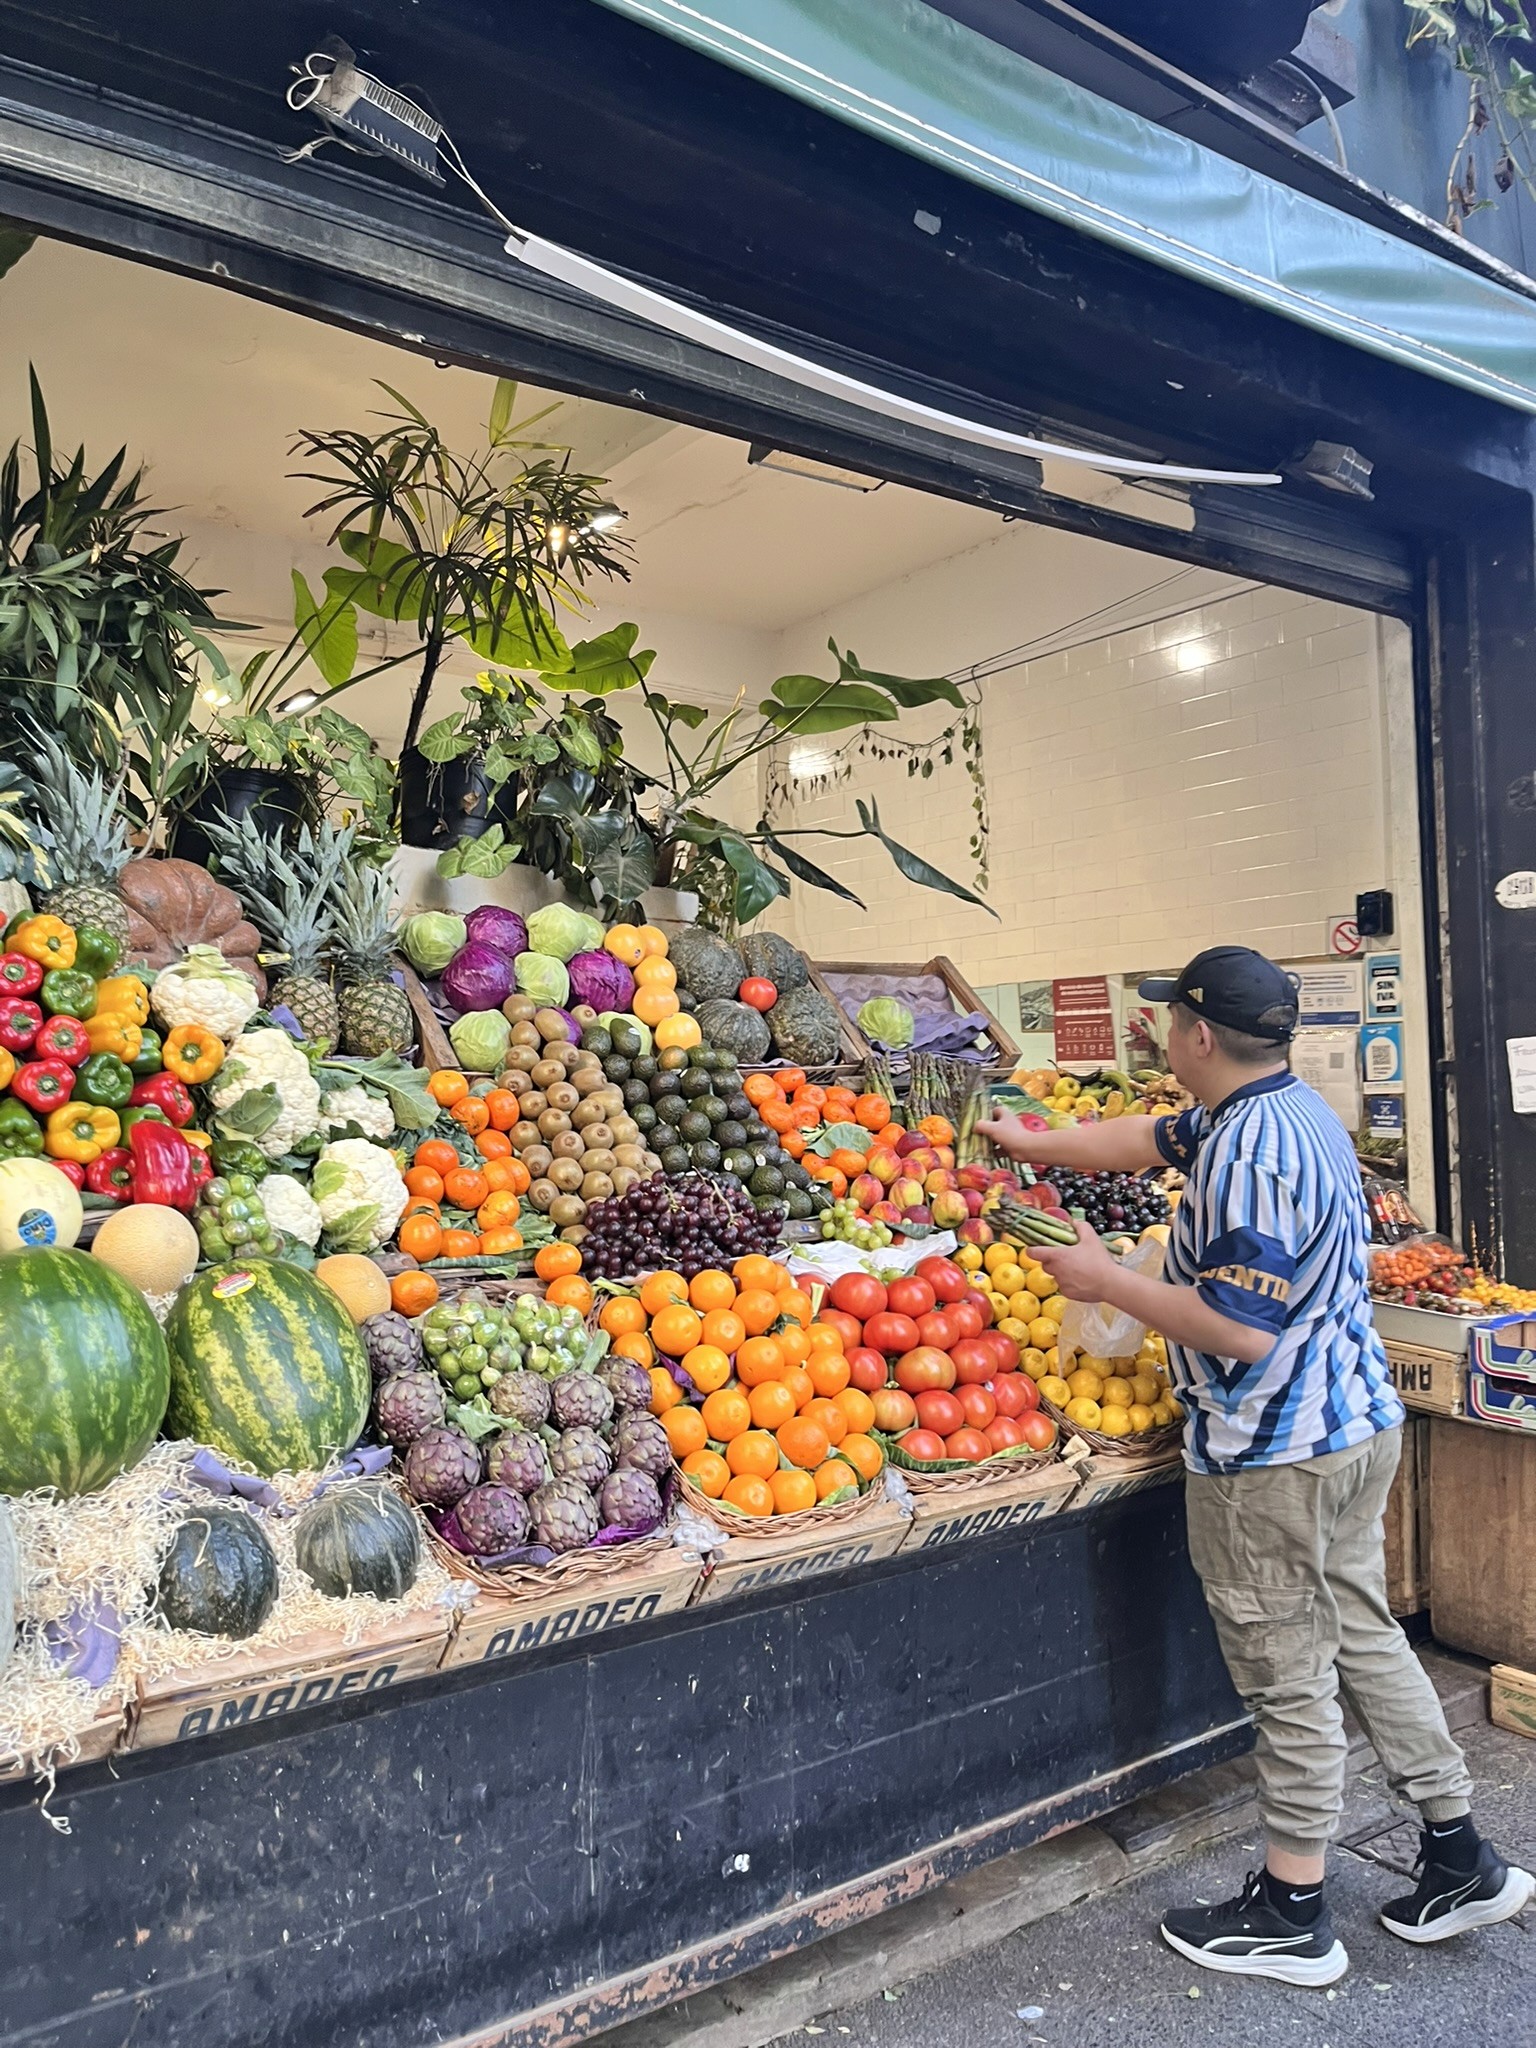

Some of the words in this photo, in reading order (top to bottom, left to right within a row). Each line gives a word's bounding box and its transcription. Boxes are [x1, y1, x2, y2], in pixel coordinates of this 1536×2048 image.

[921, 1501, 1046, 1548] AMADEO
[483, 1593, 663, 1660] AMADEO
[177, 1663, 400, 1740] AMADEO
